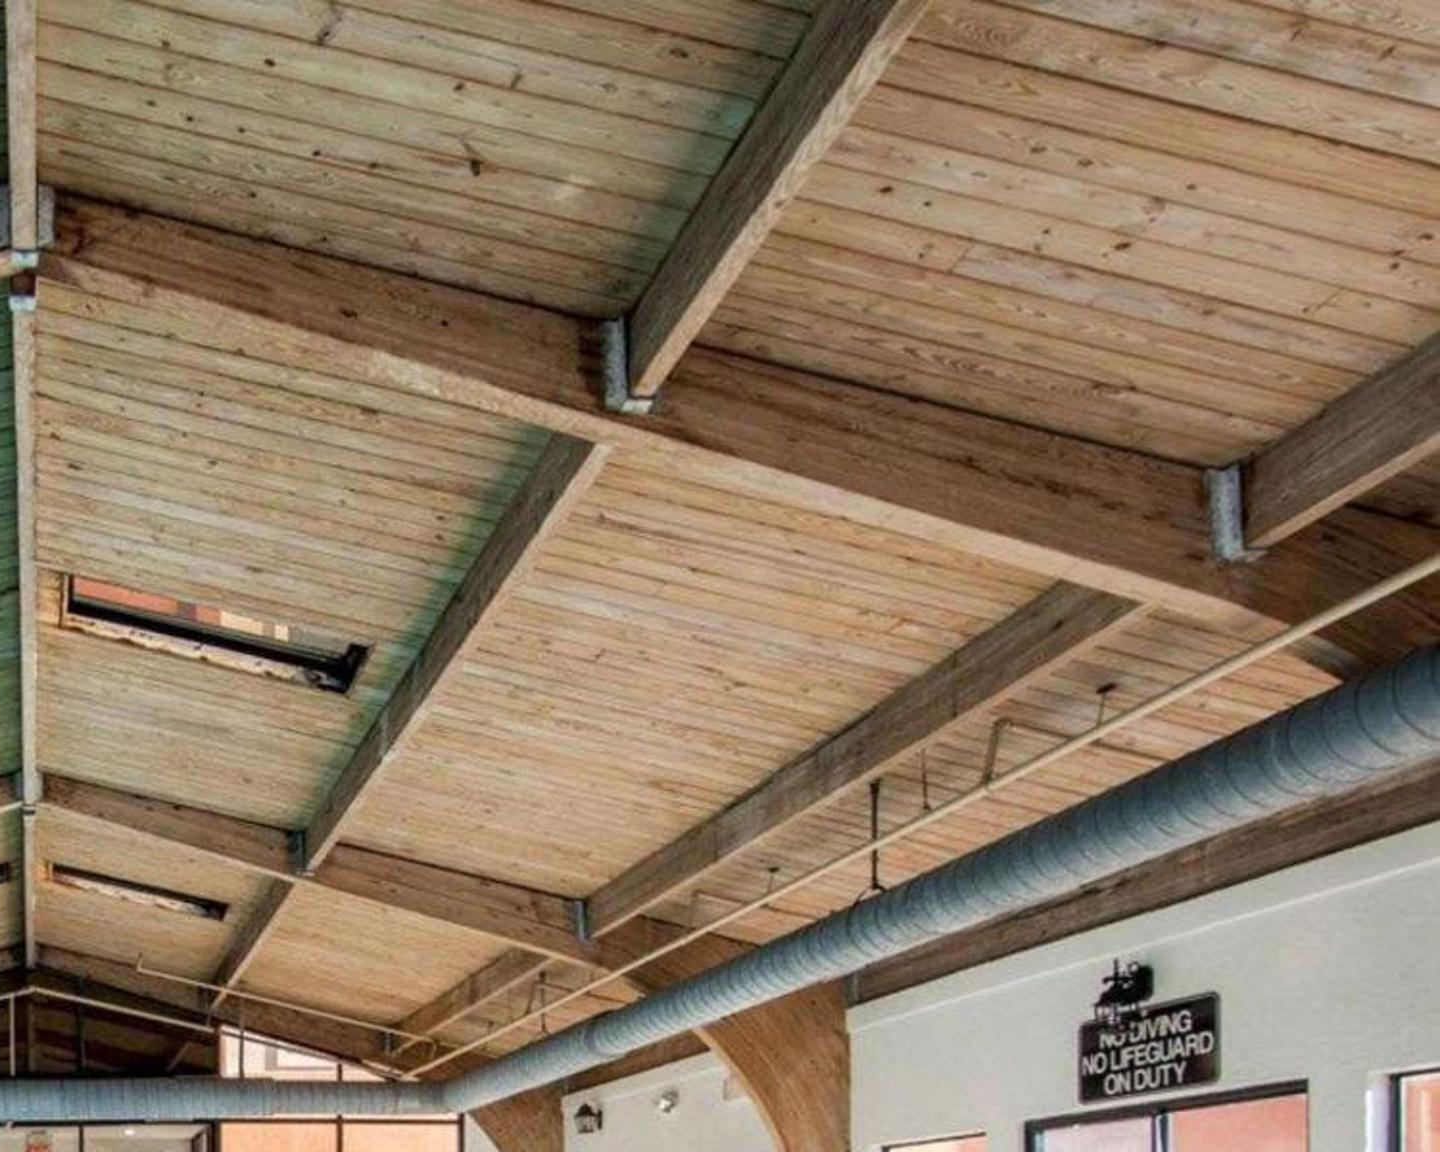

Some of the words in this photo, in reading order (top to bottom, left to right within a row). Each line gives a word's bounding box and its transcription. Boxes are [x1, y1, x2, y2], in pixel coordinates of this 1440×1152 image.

[1130, 1010, 1192, 1043] DIVING
[1082, 1052, 1107, 1075] NO
[1111, 1031, 1214, 1070] LIFEGUARD
[1104, 1074, 1131, 1094] ON
[1134, 1061, 1186, 1090] DUTY
